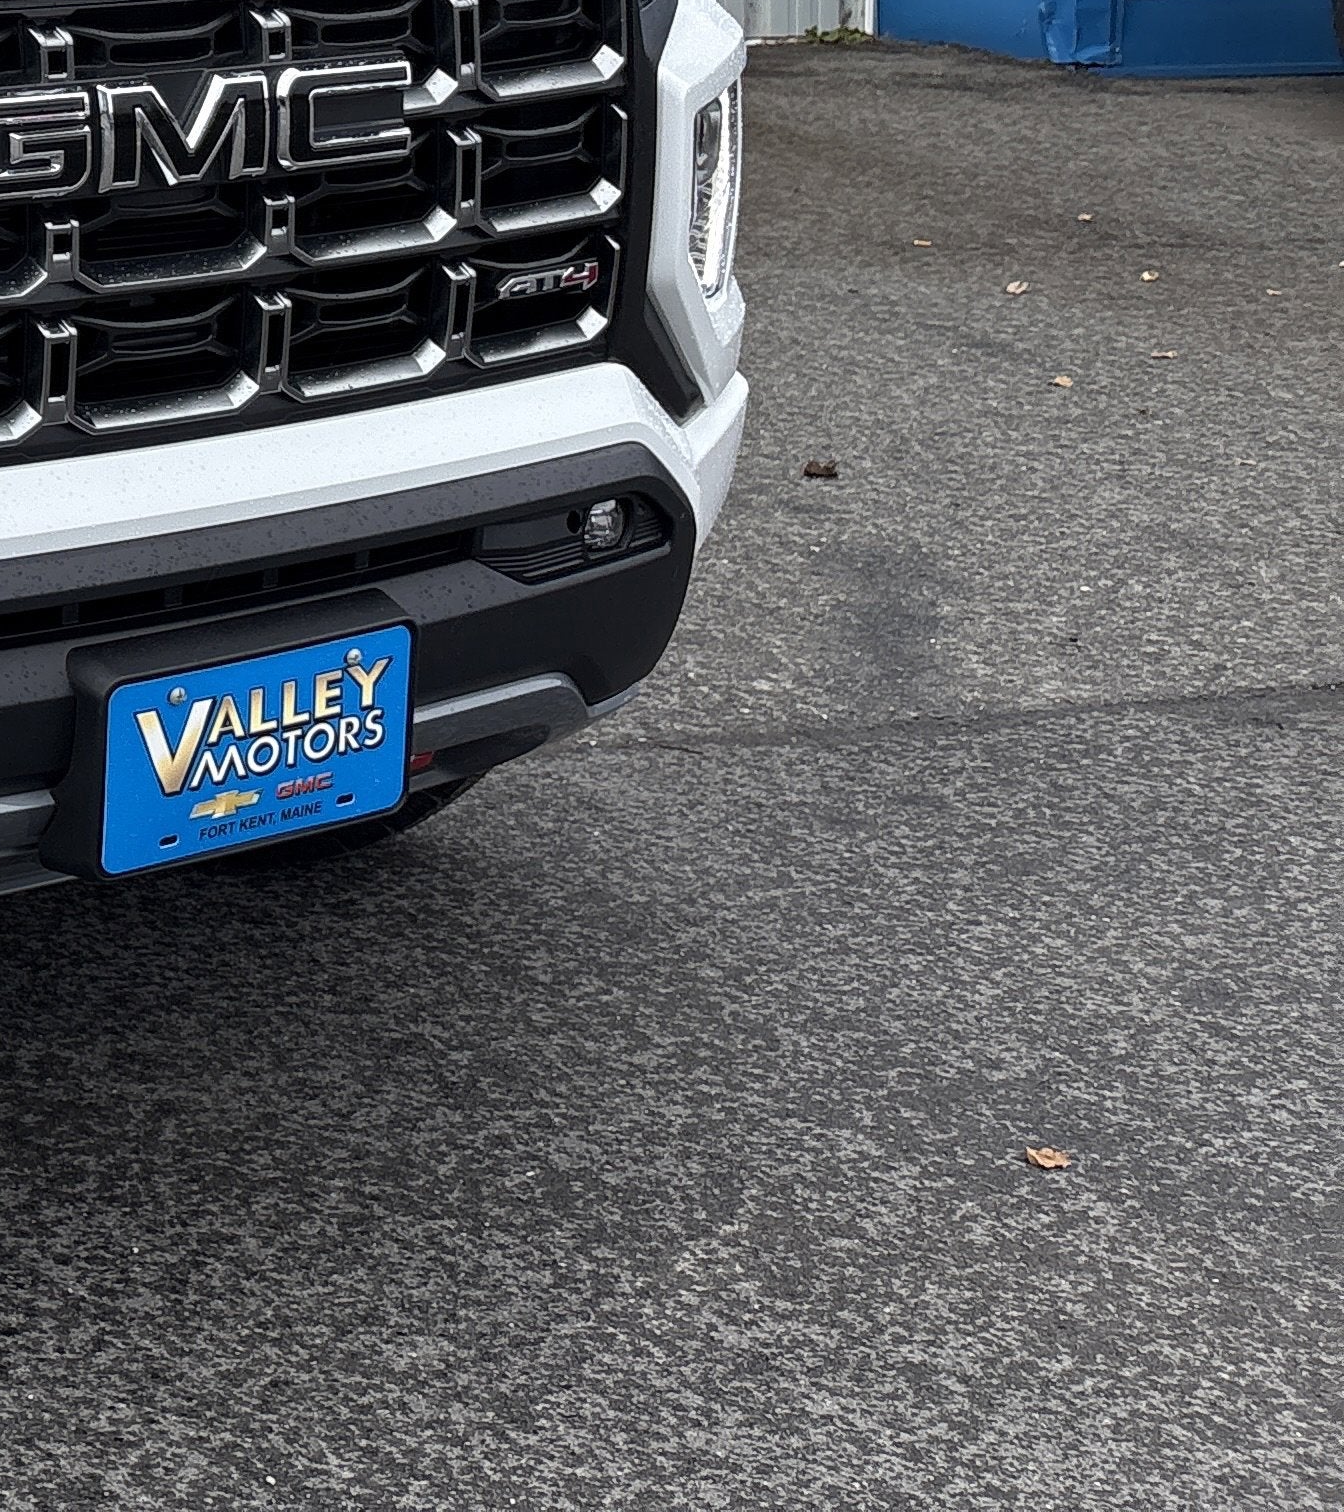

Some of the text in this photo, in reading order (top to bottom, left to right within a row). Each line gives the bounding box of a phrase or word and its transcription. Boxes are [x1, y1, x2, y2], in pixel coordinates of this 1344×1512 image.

[496, 261, 599, 300] AT4
[134, 654, 394, 798] VALLEY
[189, 707, 385, 790] MOTORS
[275, 771, 334, 800] GMC
[199, 800, 323, 840] FORT KENT, MAINE
